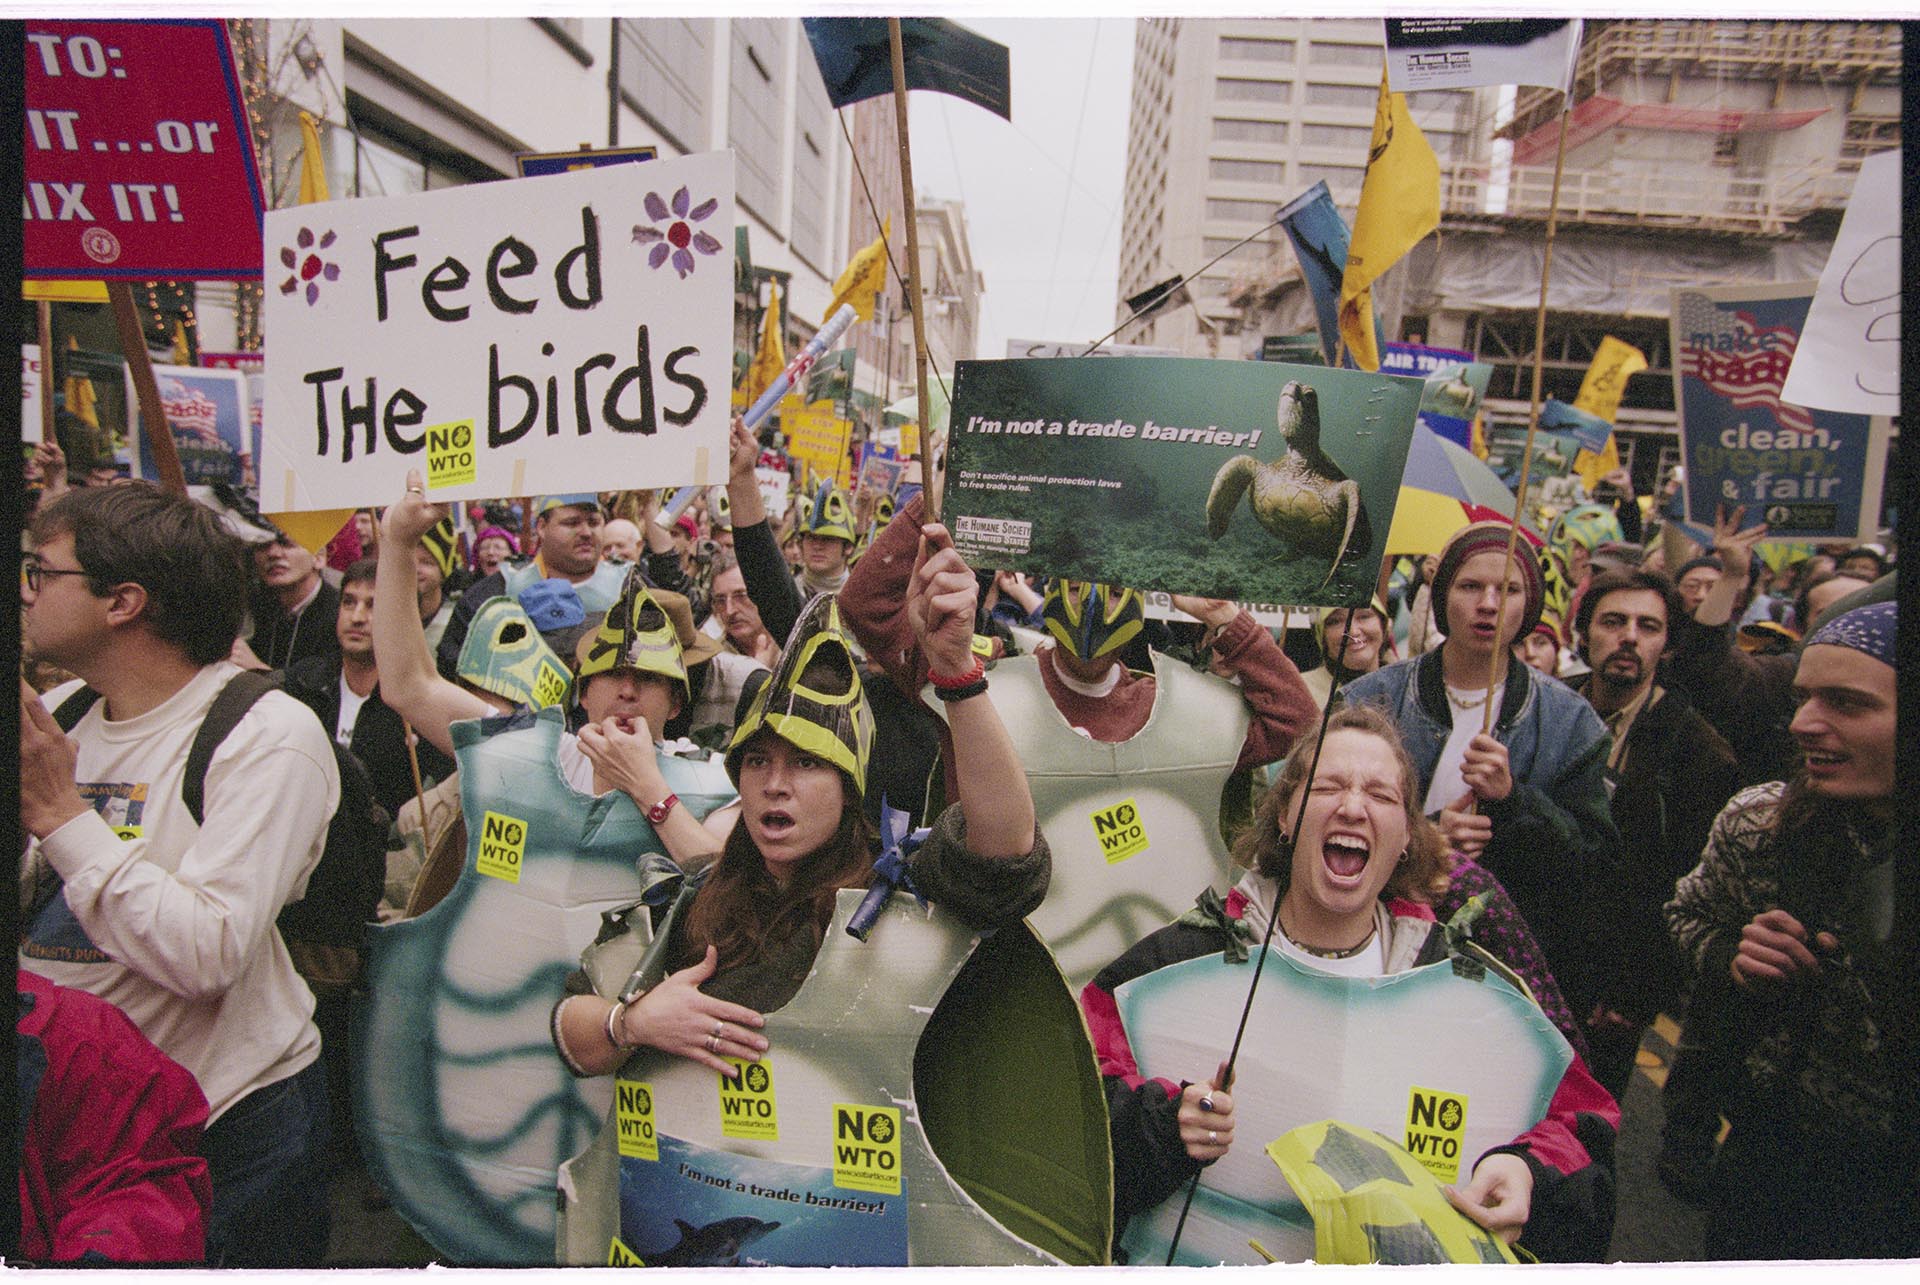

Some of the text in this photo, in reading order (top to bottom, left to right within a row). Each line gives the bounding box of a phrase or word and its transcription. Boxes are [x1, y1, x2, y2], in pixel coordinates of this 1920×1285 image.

[27, 33, 127, 79] TO:
[23, 182, 185, 222] IX IT!
[372, 203, 603, 322] Feed
[1690, 326, 1780, 352] make
[1382, 352, 1414, 369] AIR
[487, 324, 708, 449] birds
[429, 425, 472, 454] NO
[967, 415, 1262, 449] I'm not a trade barrier!
[1720, 422, 1843, 451] clean,
[430, 452, 472, 473] WTO
[960, 471, 1122, 489] Don't sacrifice animal protection laws
[960, 480, 1031, 492] to free trade rules.
[1722, 470, 1841, 501] & fair
[957, 517, 1030, 537] THE HUMANE SOCIETY
[543, 665, 564, 697] NO
[486, 816, 522, 846] NO
[1094, 804, 1135, 835] NO
[1101, 825, 1141, 850] WTO
[483, 842, 518, 866] WTO
[721, 1063, 769, 1094] NO
[619, 1086, 651, 1116] NO
[722, 1096, 772, 1118] WTO
[1411, 1092, 1463, 1132] NO
[620, 1117, 653, 1139] WTO
[838, 1109, 895, 1144] NO
[837, 1145, 895, 1170] WTO
[1407, 1131, 1457, 1158] WTO
[679, 1161, 887, 1216] I'm not a trade barrier!
